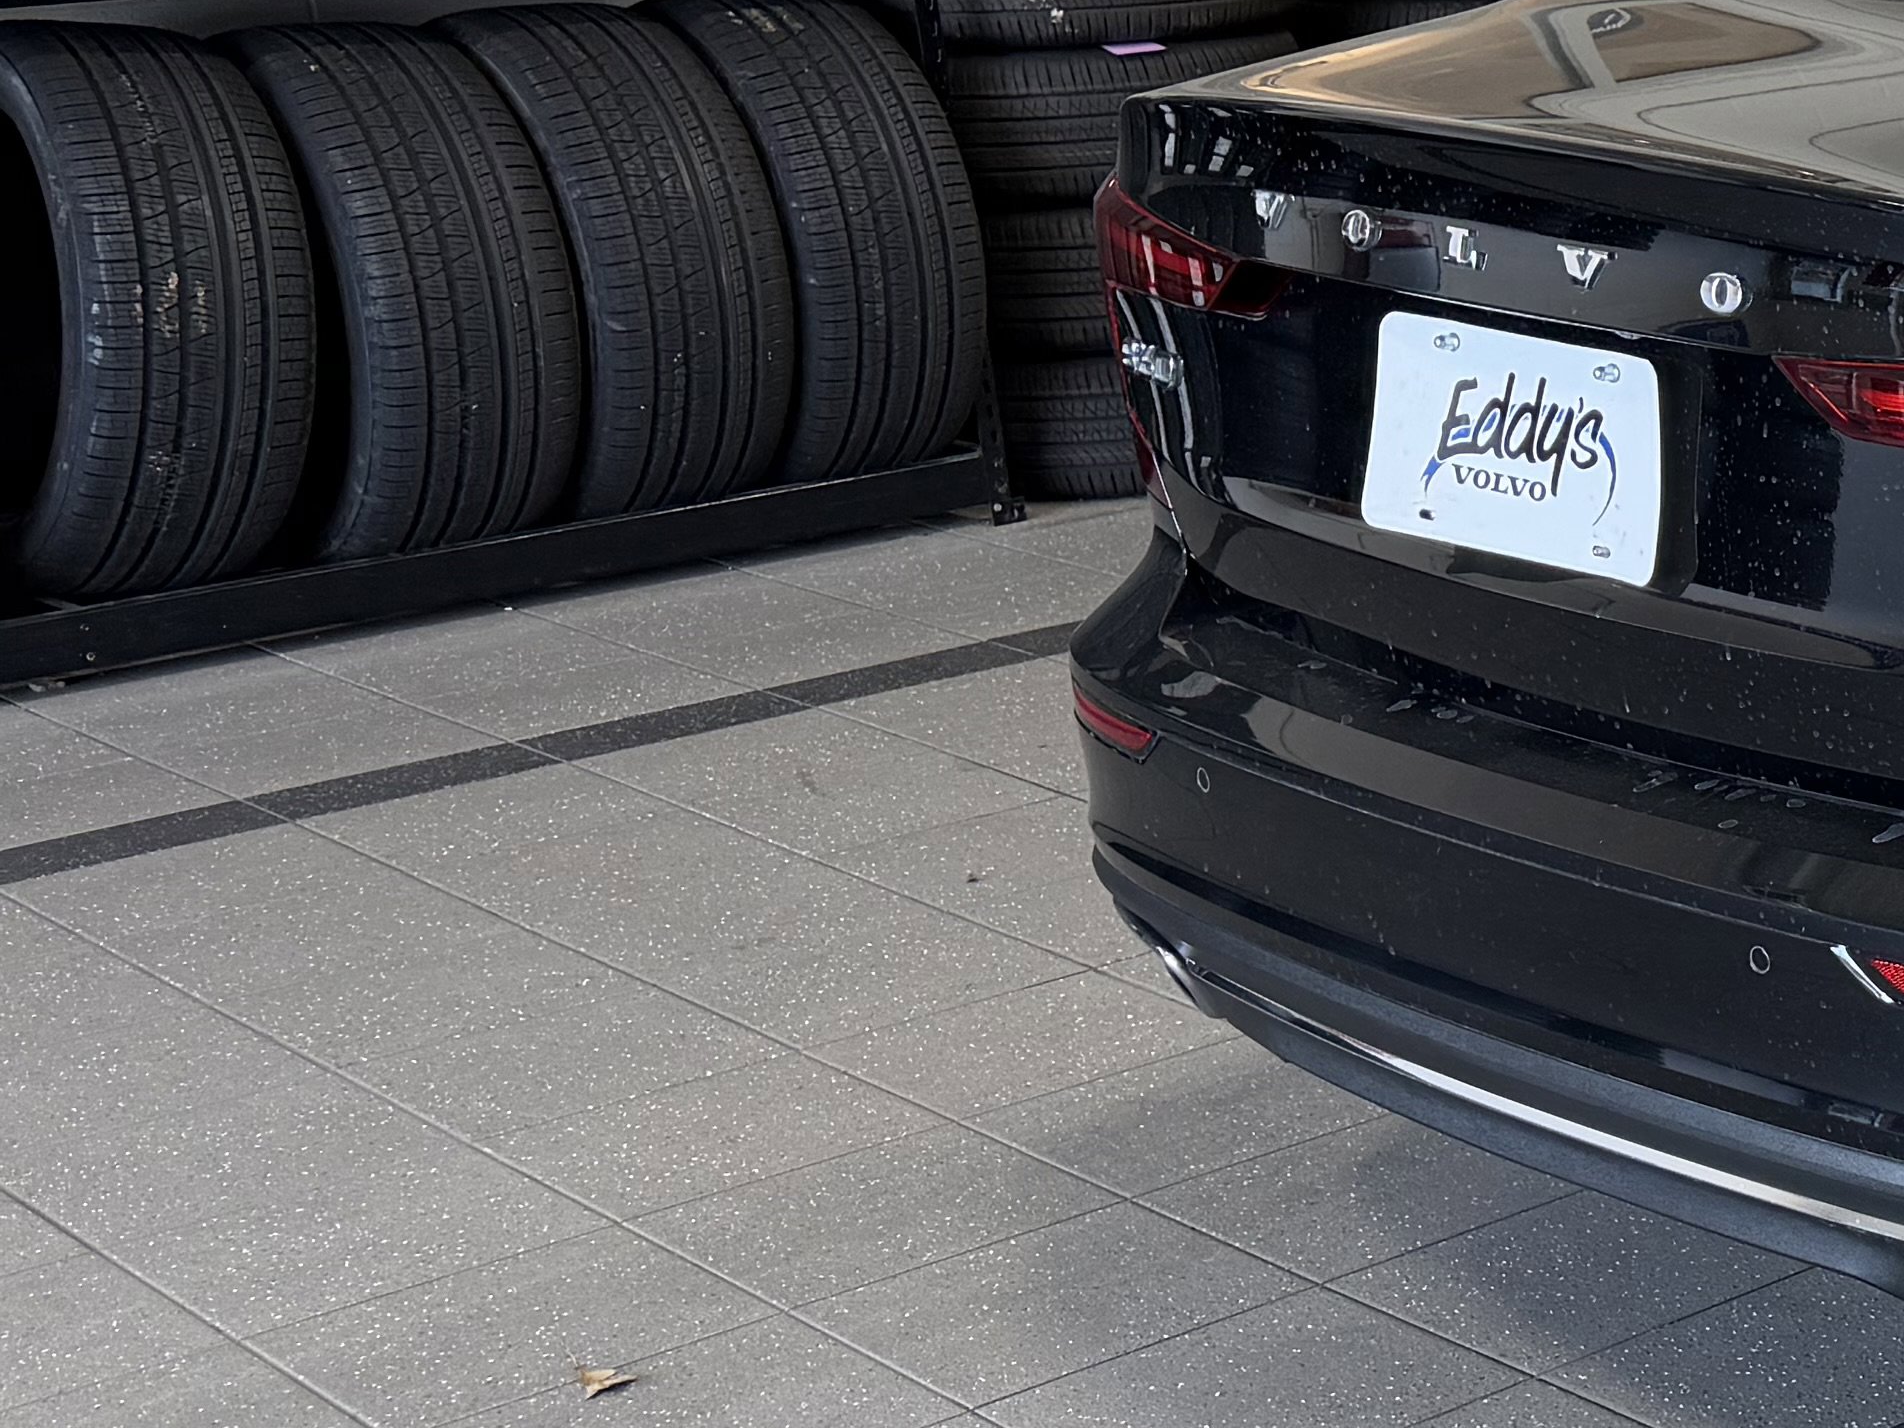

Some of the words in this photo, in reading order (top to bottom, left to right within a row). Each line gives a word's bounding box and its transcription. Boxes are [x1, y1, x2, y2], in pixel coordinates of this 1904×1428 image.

[1251, 189, 1754, 316] VOLVO
[1437, 372, 1604, 498] Eddy's
[1451, 463, 1547, 502] VOLVO
